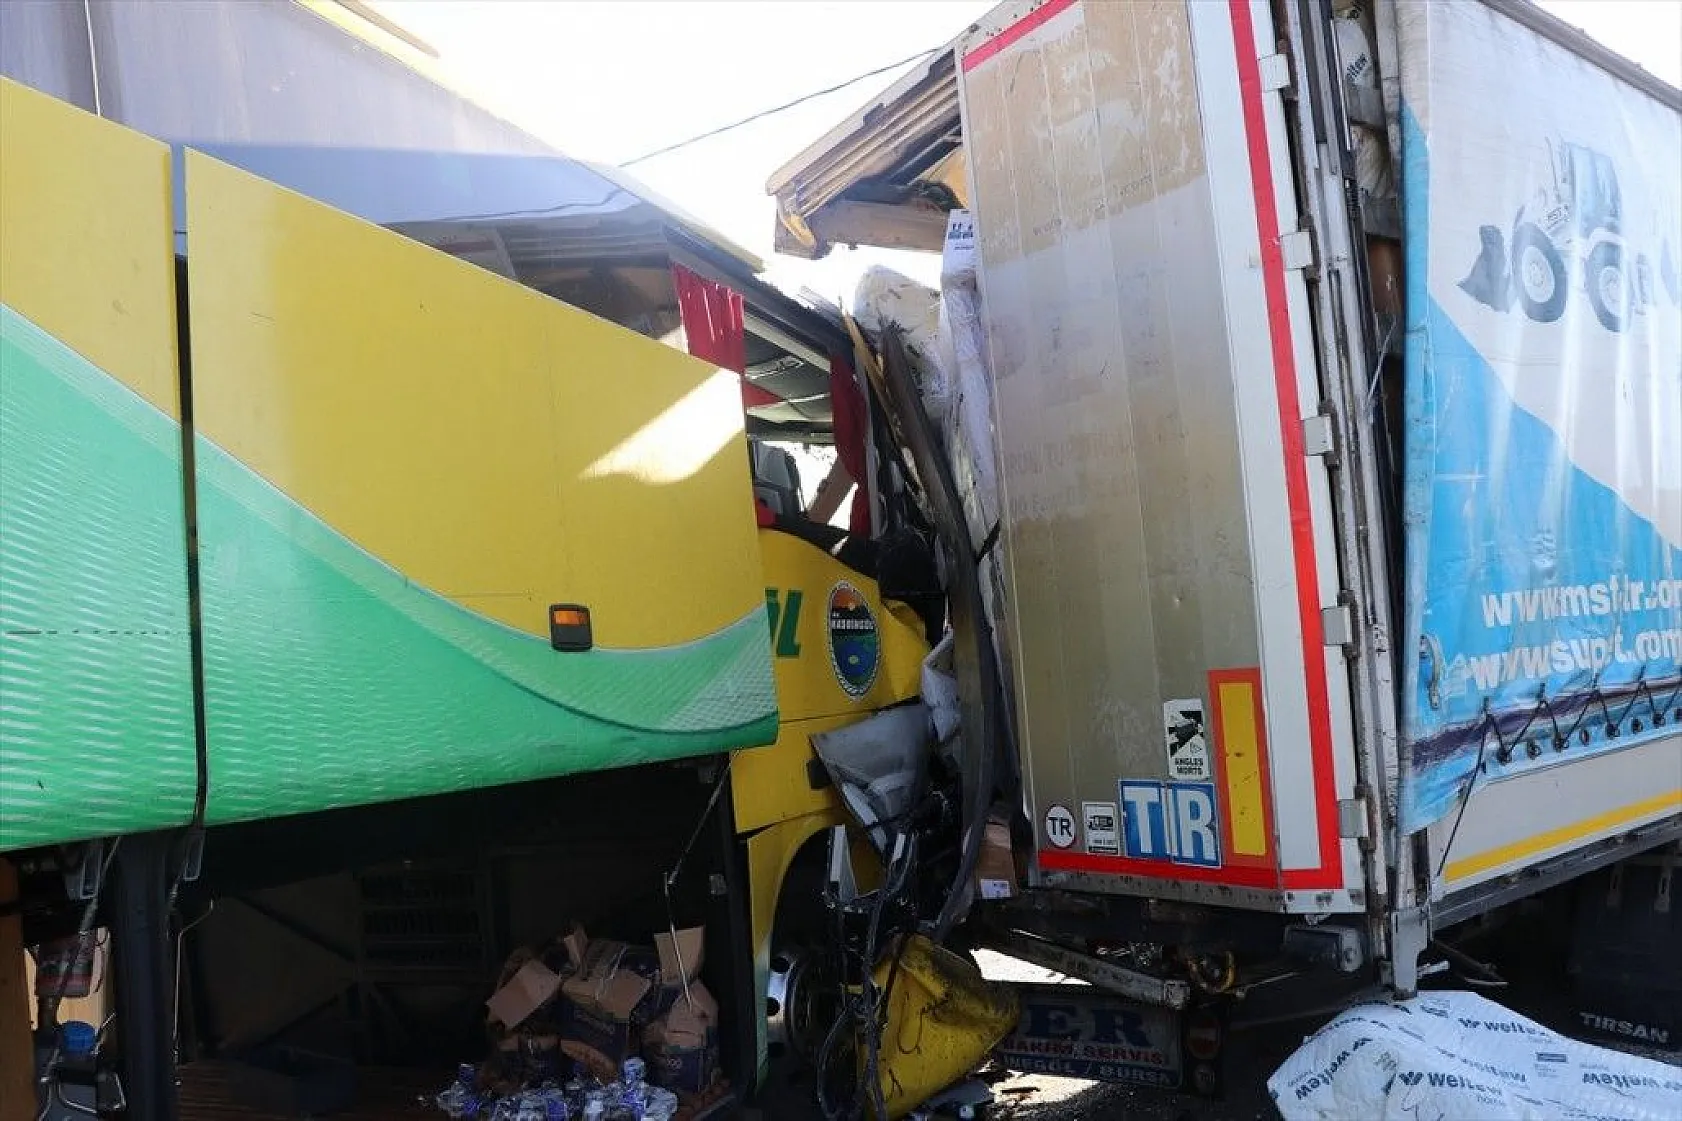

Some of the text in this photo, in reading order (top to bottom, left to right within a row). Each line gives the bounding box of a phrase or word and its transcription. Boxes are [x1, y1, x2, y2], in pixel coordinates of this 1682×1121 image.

[1174, 757, 1204, 766] ANGLES
[1176, 766, 1204, 776] MORTS
[1047, 816, 1073, 837] TR
[1122, 785, 1218, 862] TIR
[1579, 1011, 1670, 1044] TIRSAN
